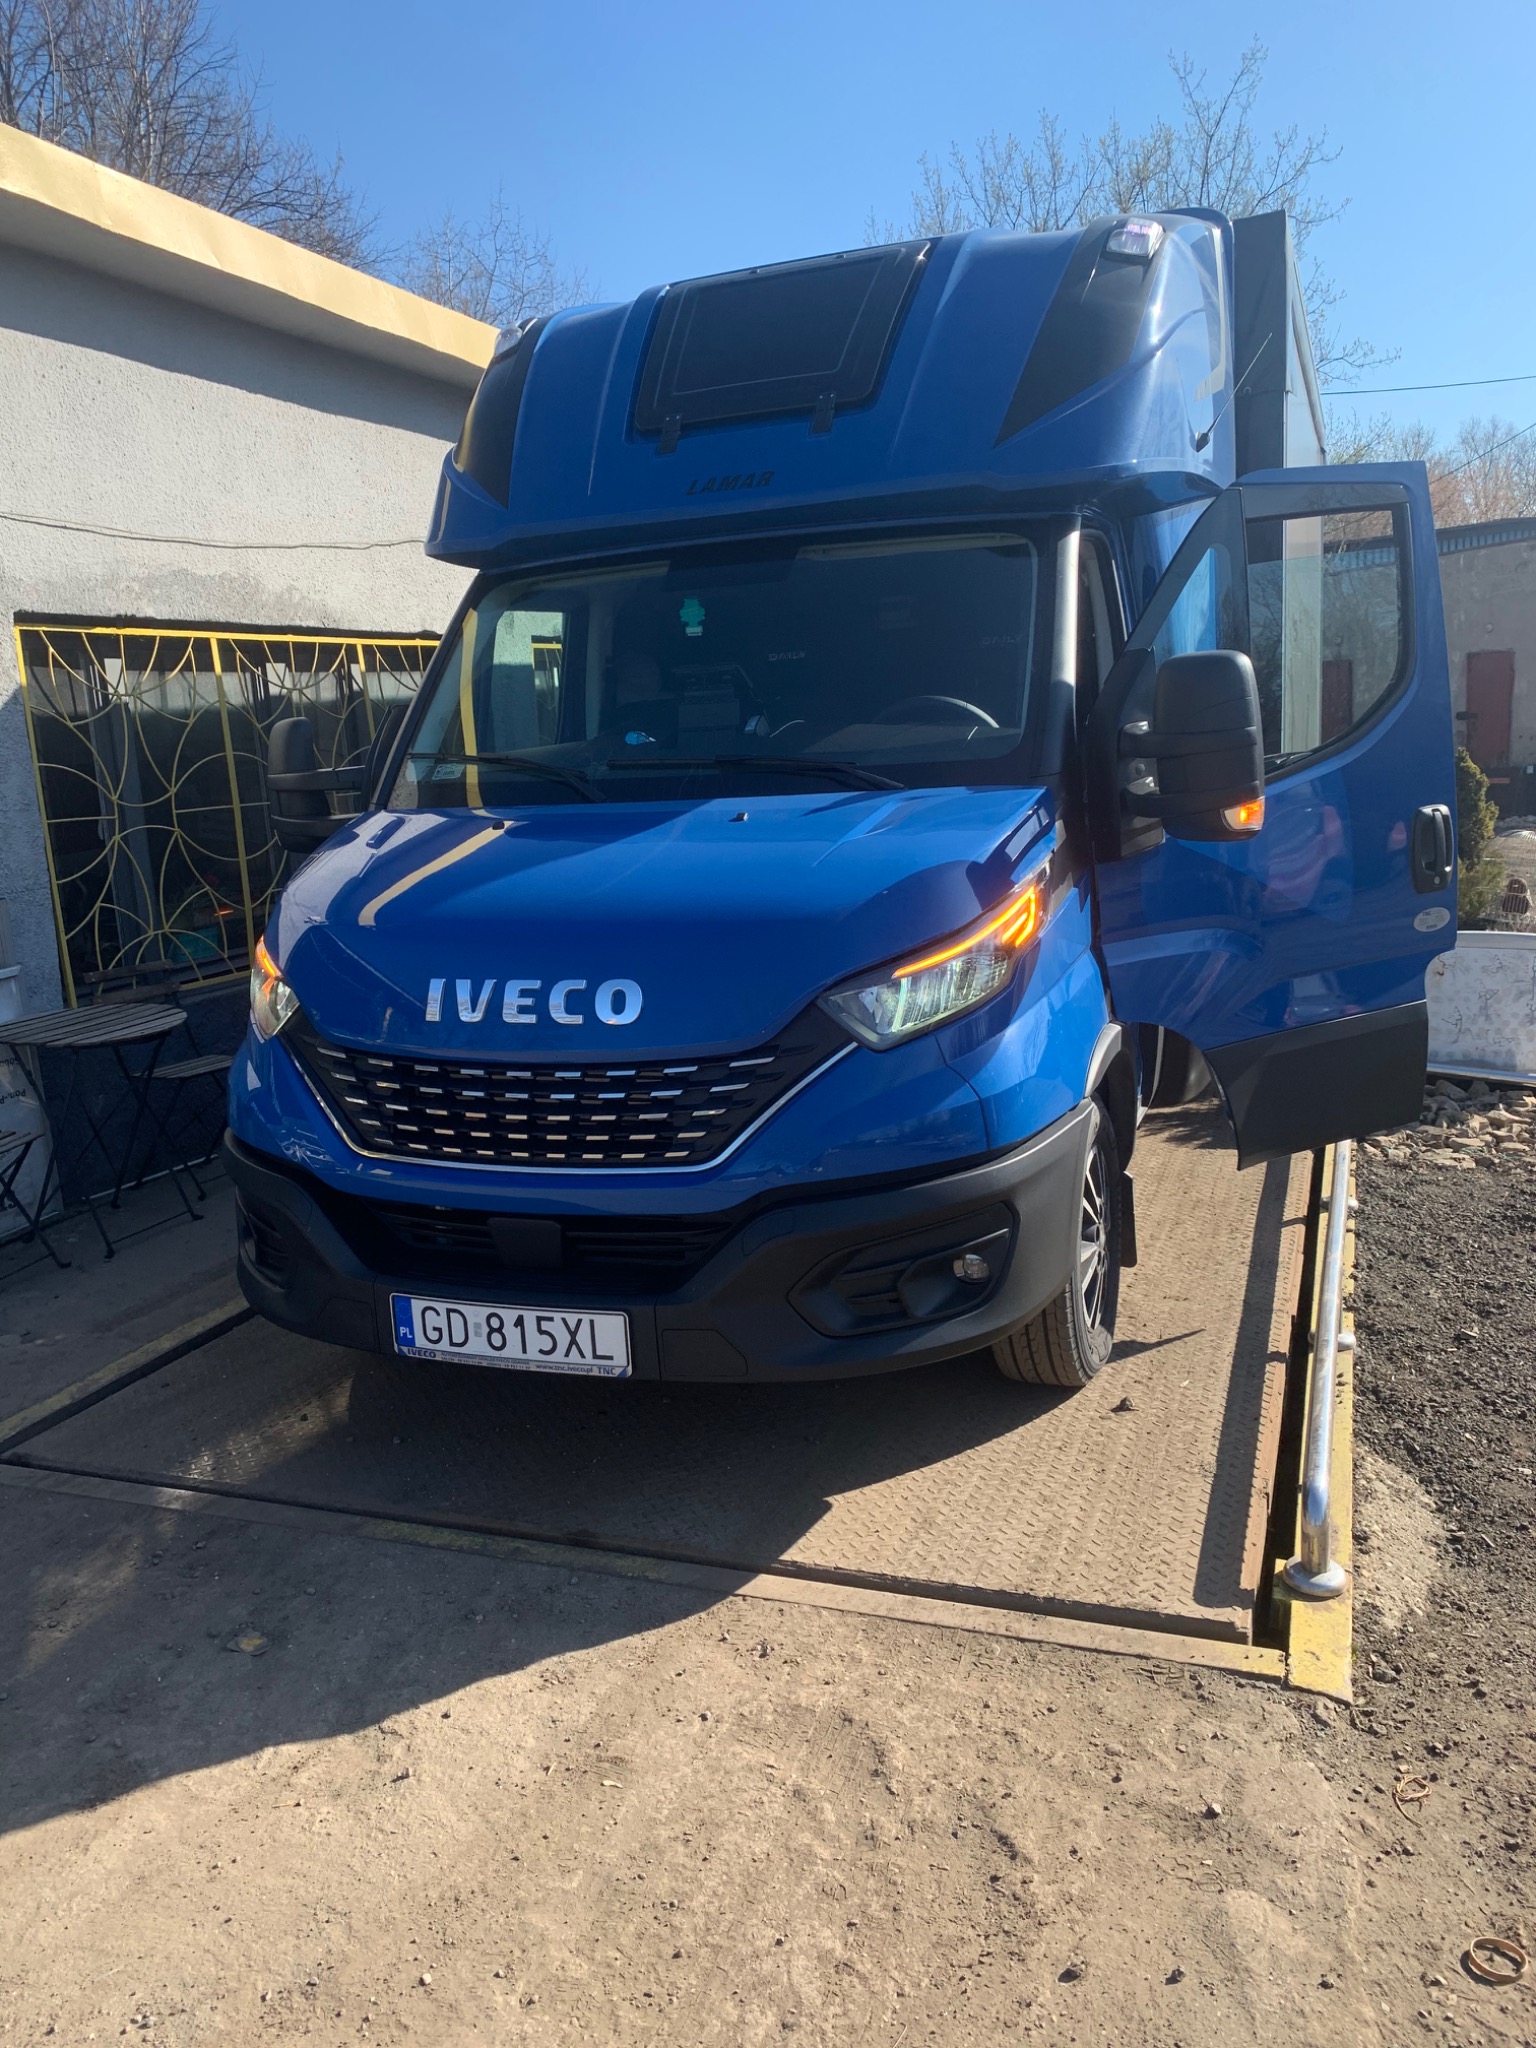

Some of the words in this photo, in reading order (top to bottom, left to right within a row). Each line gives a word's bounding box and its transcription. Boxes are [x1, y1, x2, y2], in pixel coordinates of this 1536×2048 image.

[686, 470, 775, 496] LAMAR
[425, 978, 643, 1025] IVECO
[399, 1326, 413, 1339] PL
[420, 1305, 469, 1348] GD
[485, 1312, 614, 1361] 815XL
[407, 1348, 437, 1359] IVECO
[597, 1366, 617, 1376] TNC
